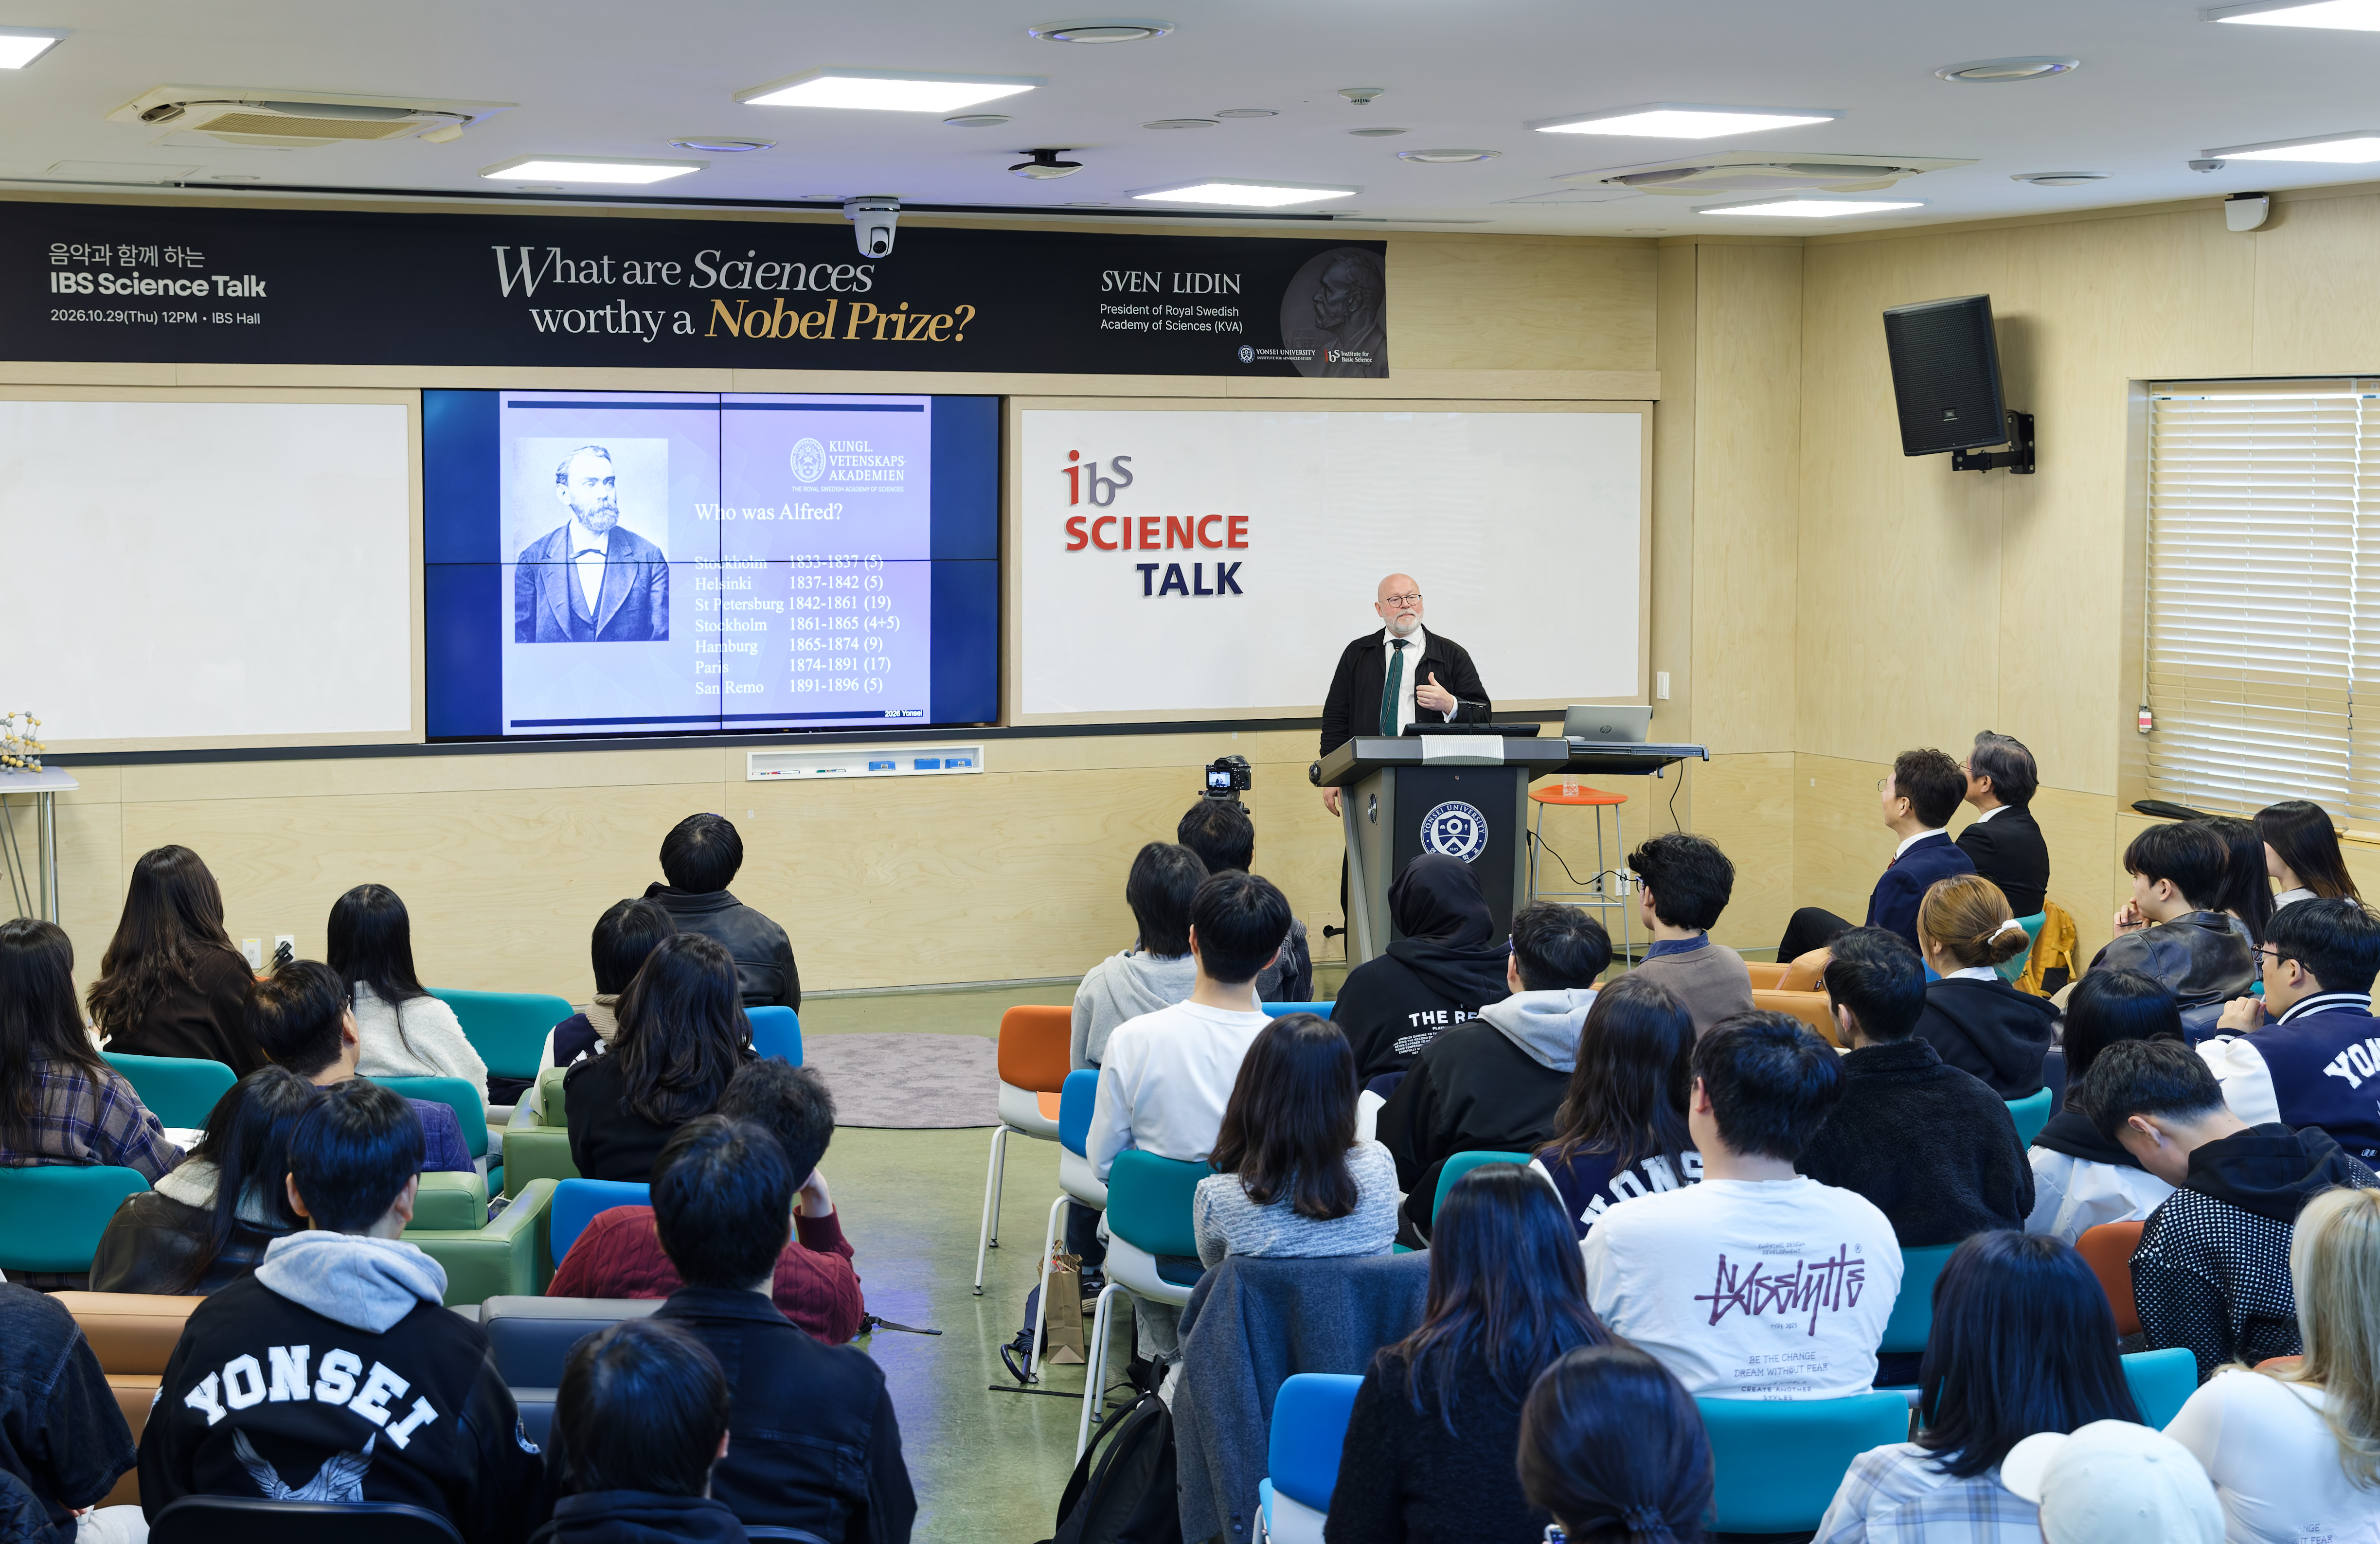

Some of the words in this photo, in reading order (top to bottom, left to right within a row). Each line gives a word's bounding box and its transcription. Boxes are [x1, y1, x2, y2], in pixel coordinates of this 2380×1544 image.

[49, 243, 112, 266] 음악과
[118, 245, 159, 267] 함께
[164, 246, 205, 268] 하는
[491, 246, 615, 298] What
[623, 260, 681, 286] are
[689, 249, 876, 293] Sciences
[51, 271, 94, 294] IBS
[98, 271, 209, 297] Science
[211, 275, 267, 297] Talk
[1102, 270, 1162, 292] SVEN
[1173, 272, 1241, 294] LIDIN
[51, 309, 159, 325] 2026.10.29(Thu)
[162, 312, 197, 323] 12PM
[212, 312, 233, 324] IBS
[237, 313, 260, 324] Hall
[1100, 304, 1149, 315] President
[1152, 304, 1163, 315] of
[1165, 305, 1193, 317] Royal
[1196, 305, 1239, 317] Swedish
[529, 299, 666, 343] worthy
[673, 312, 695, 335] a
[704, 297, 838, 338] Nobel
[842, 302, 976, 343] Prize?
[1101, 319, 1149, 333] Academy
[1152, 319, 1163, 330] of
[1165, 320, 1211, 332] Sciences
[1215, 321, 1243, 334] (KVA)
[829, 441, 873, 452] KUNGL.
[829, 455, 907, 466] VETENSKAPS-
[829, 470, 904, 480] AKADEMIEN
[1061, 450, 1133, 507] ibs
[695, 503, 736, 520] Who
[741, 508, 774, 520] was
[779, 503, 843, 520] Alfred?
[1065, 514, 1249, 550] SCIENCE
[695, 555, 768, 569] Stockholm
[864, 554, 883, 571] (5)
[695, 576, 752, 590] Helsinki
[790, 575, 859, 589] 1837-1842
[864, 575, 883, 591] (5)
[1135, 562, 1244, 596] TALK
[695, 598, 709, 611] St
[714, 597, 785, 613] Petersburg
[789, 596, 857, 610] 1842-1861
[864, 595, 891, 612] (19)
[695, 618, 768, 632] Stockholm
[790, 617, 859, 631] 1861-1865
[864, 616, 900, 632] (4+5)
[695, 639, 758, 655] Hamburg
[790, 637, 859, 651] 1865-1874
[864, 637, 883, 653] (9)
[695, 660, 729, 674] Paris
[790, 657, 858, 672] 1874-1891
[864, 657, 891, 674] (17)
[695, 681, 720, 695] San
[725, 680, 764, 694] Remo
[790, 678, 859, 692] 1891-1896
[864, 677, 883, 694] (5)
[1424, 808, 1444, 834] YONSEI
[1447, 804, 1485, 834] UNIVERSITY
[1409, 1010, 1449, 1027] THE
[1749, 1355, 1760, 1364] BE
[1763, 1354, 1779, 1363] THE
[1781, 1351, 1816, 1362] CHANGE
[1734, 1368, 1764, 1377] DREAM
[1767, 1365, 1804, 1376] WITHOUT
[1807, 1363, 1828, 1372] FEAR
[184, 1344, 439, 1450] YONSEI
